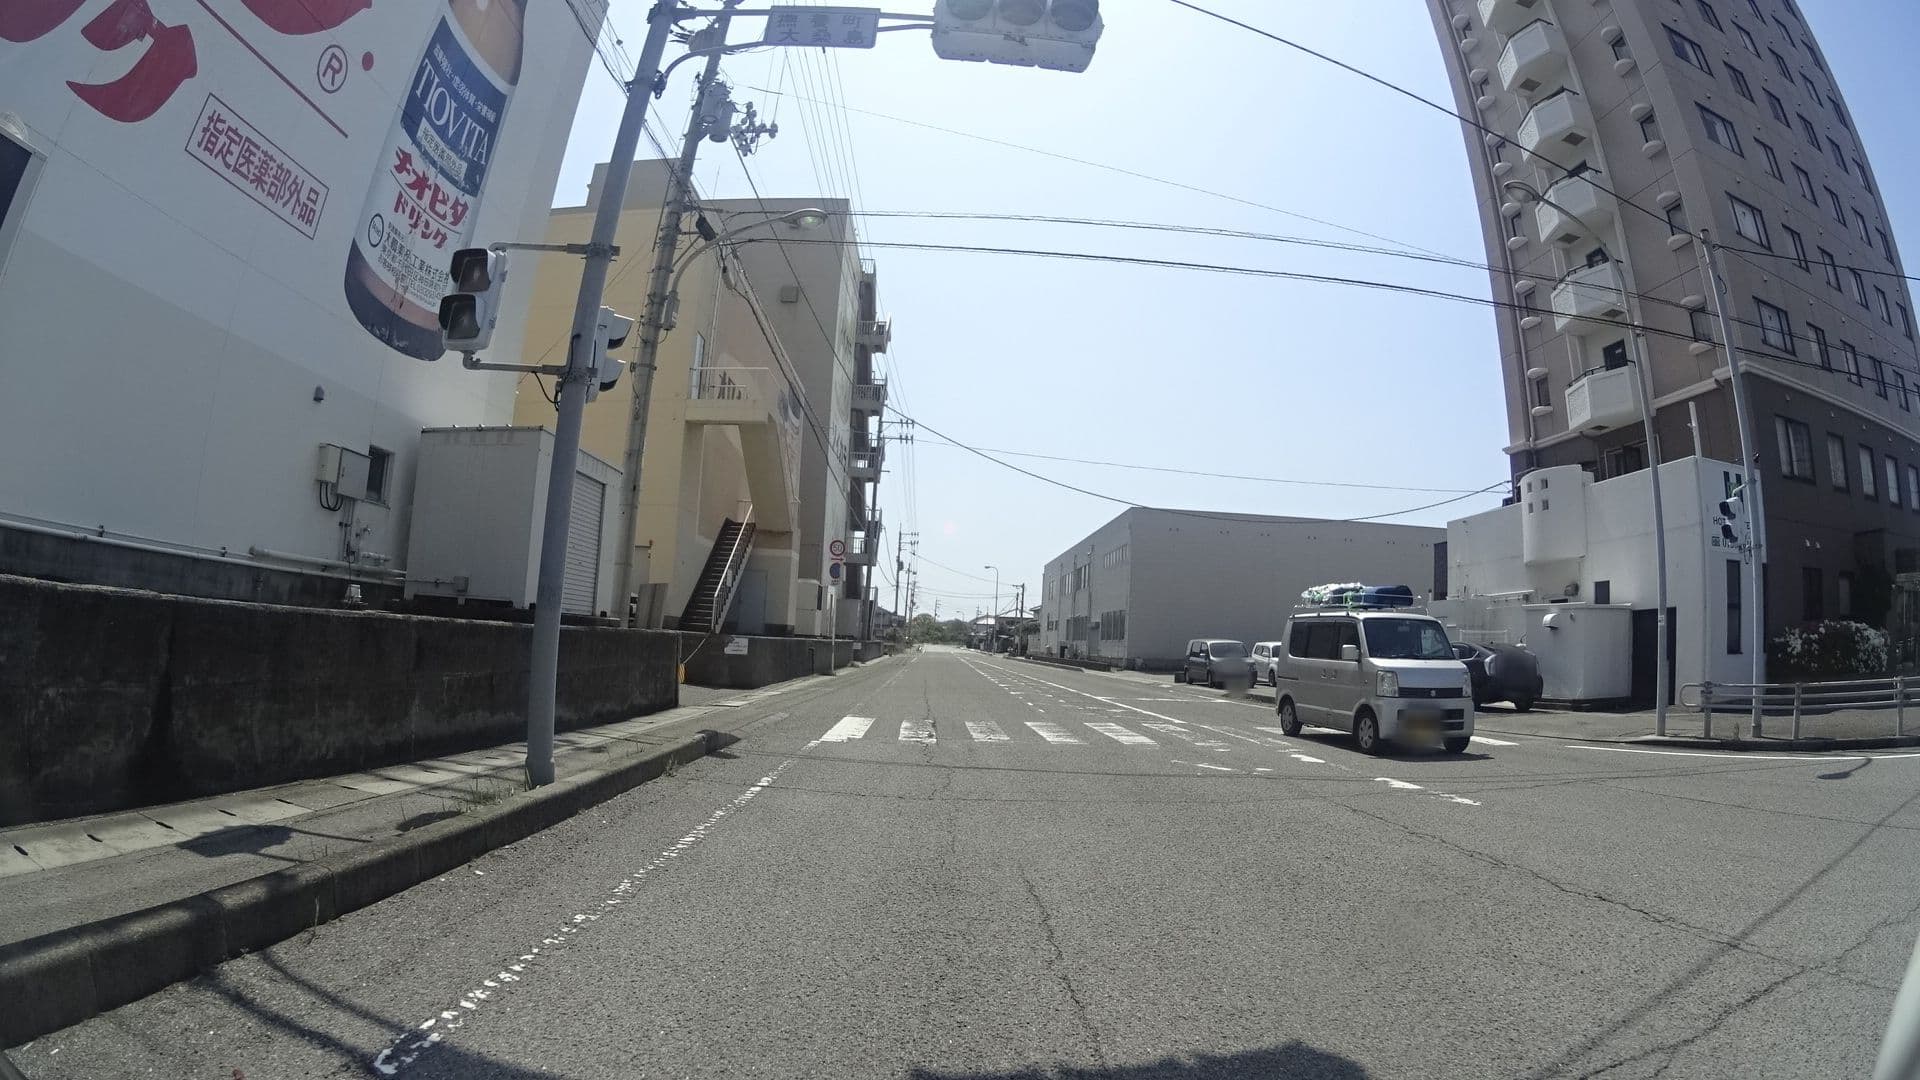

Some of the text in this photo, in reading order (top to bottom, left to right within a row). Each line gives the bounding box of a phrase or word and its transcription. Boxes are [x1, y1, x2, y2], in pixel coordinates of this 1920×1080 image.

[415, 58, 489, 165] TIOVITA
[197, 110, 320, 227] 指定医薬部外品
[393, 146, 470, 227] チオビタ
[393, 190, 448, 249] ドリンク
